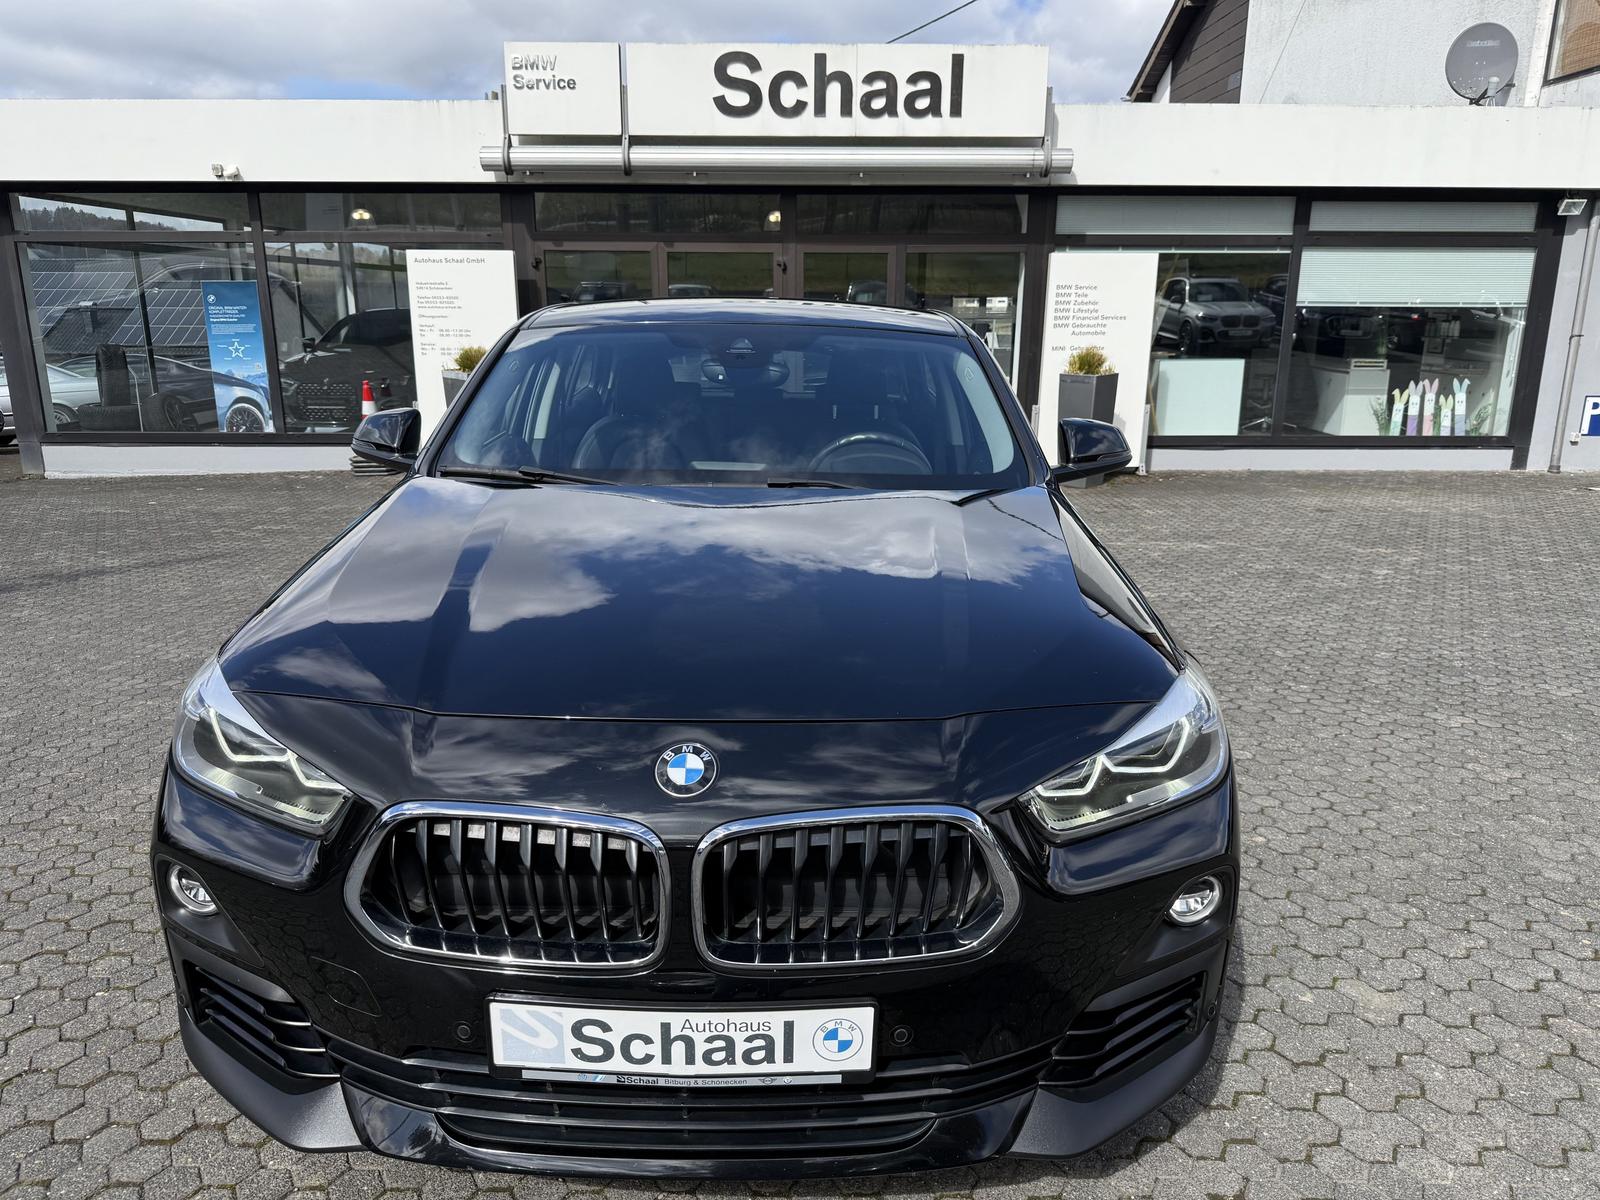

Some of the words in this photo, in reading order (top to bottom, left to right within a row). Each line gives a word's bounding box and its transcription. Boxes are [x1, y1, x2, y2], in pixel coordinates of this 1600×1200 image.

[511, 55, 557, 71] BMW
[513, 74, 577, 91] Service
[712, 51, 965, 119] Schaal
[663, 745, 711, 761] BMW
[680, 1018, 772, 1033] Autohaus
[820, 1020, 857, 1034] BMW
[570, 1018, 795, 1067] Schaal
[627, 1076, 659, 1085] Schaal
[701, 1078, 748, 1086] Schönecken
